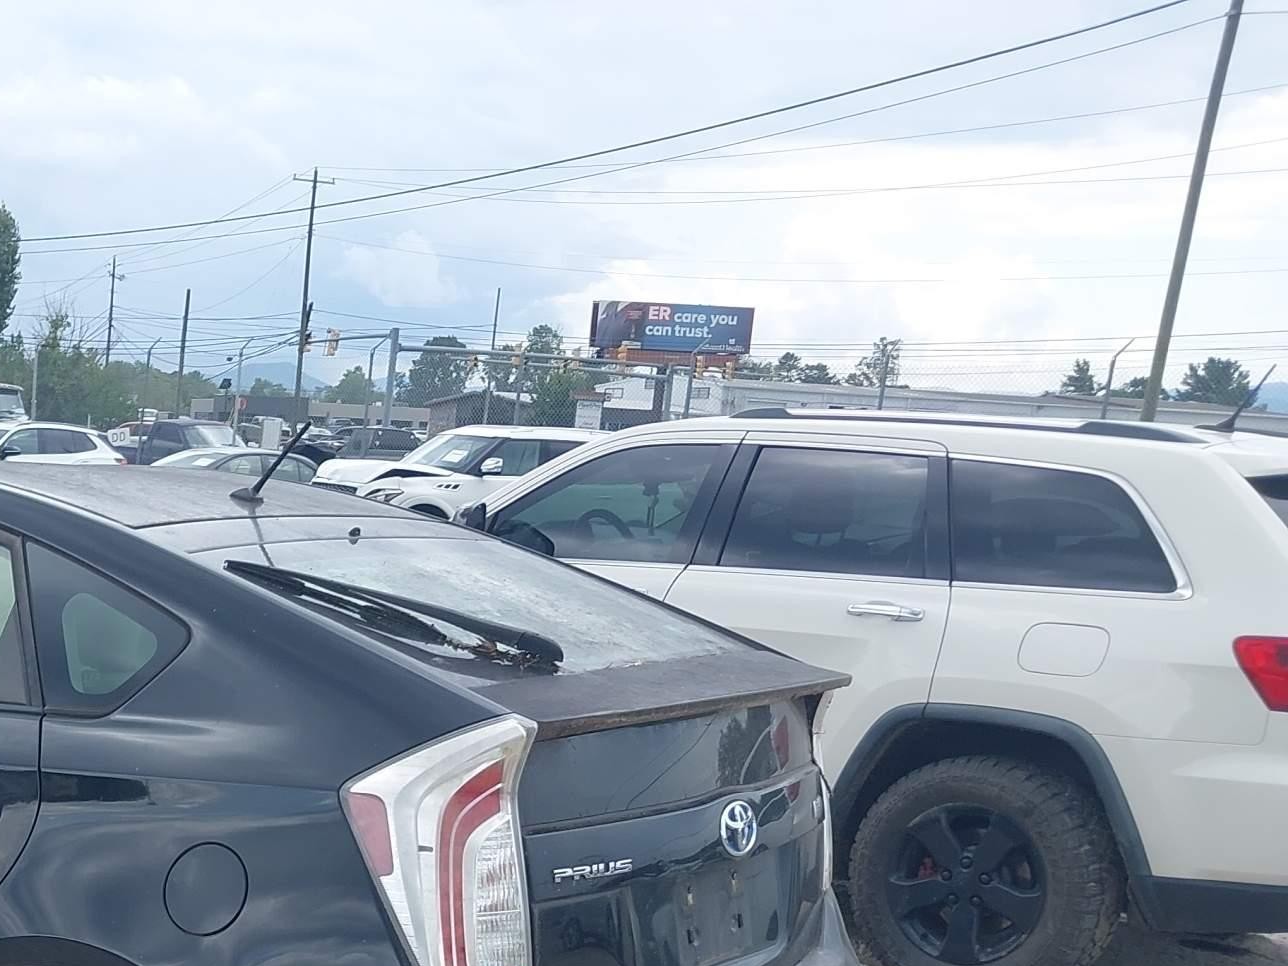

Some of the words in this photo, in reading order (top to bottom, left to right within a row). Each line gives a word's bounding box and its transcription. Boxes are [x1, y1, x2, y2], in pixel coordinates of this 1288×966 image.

[648, 306, 671, 320] ER
[674, 312, 706, 323] care
[710, 314, 737, 327] you
[645, 325, 671, 336] can
[674, 325, 712, 338] trust.
[553, 859, 633, 883] PRIUS
